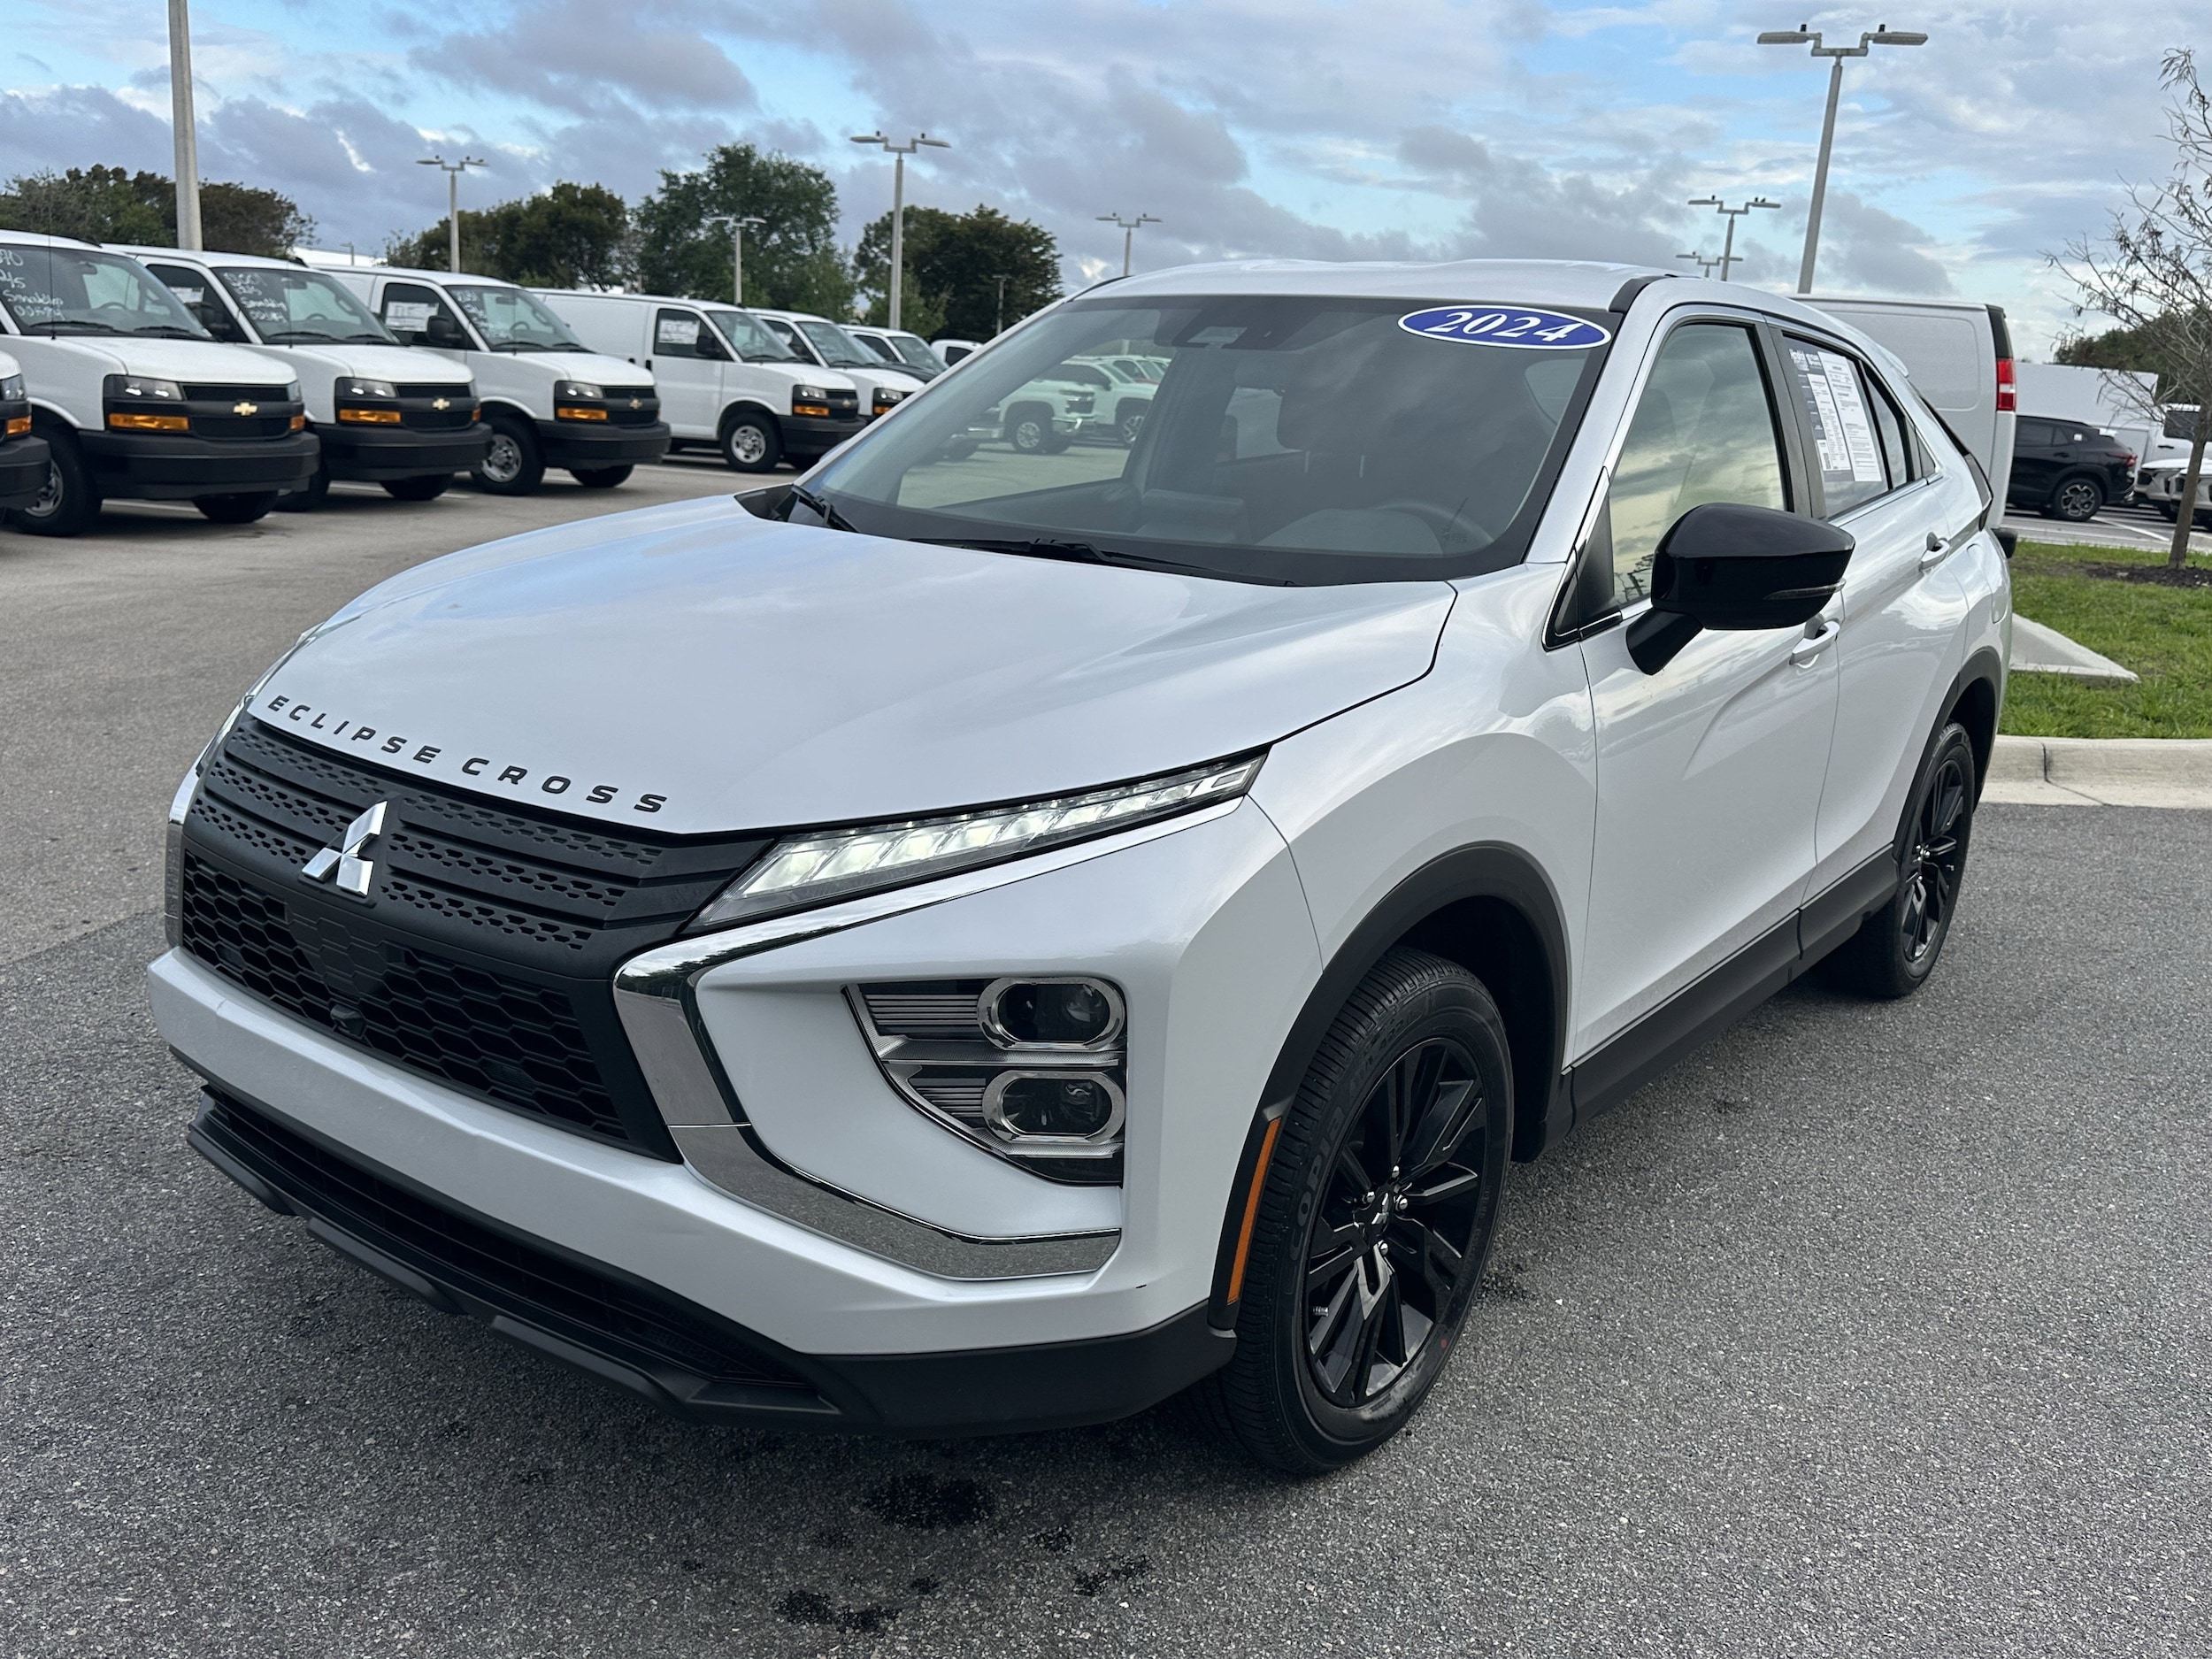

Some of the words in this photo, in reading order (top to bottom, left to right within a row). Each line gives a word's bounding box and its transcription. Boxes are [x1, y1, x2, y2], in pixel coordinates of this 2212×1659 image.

[1423, 311, 1585, 342] 2024
[267, 695, 442, 764] ECLIPSE
[461, 757, 668, 813] CROSS
